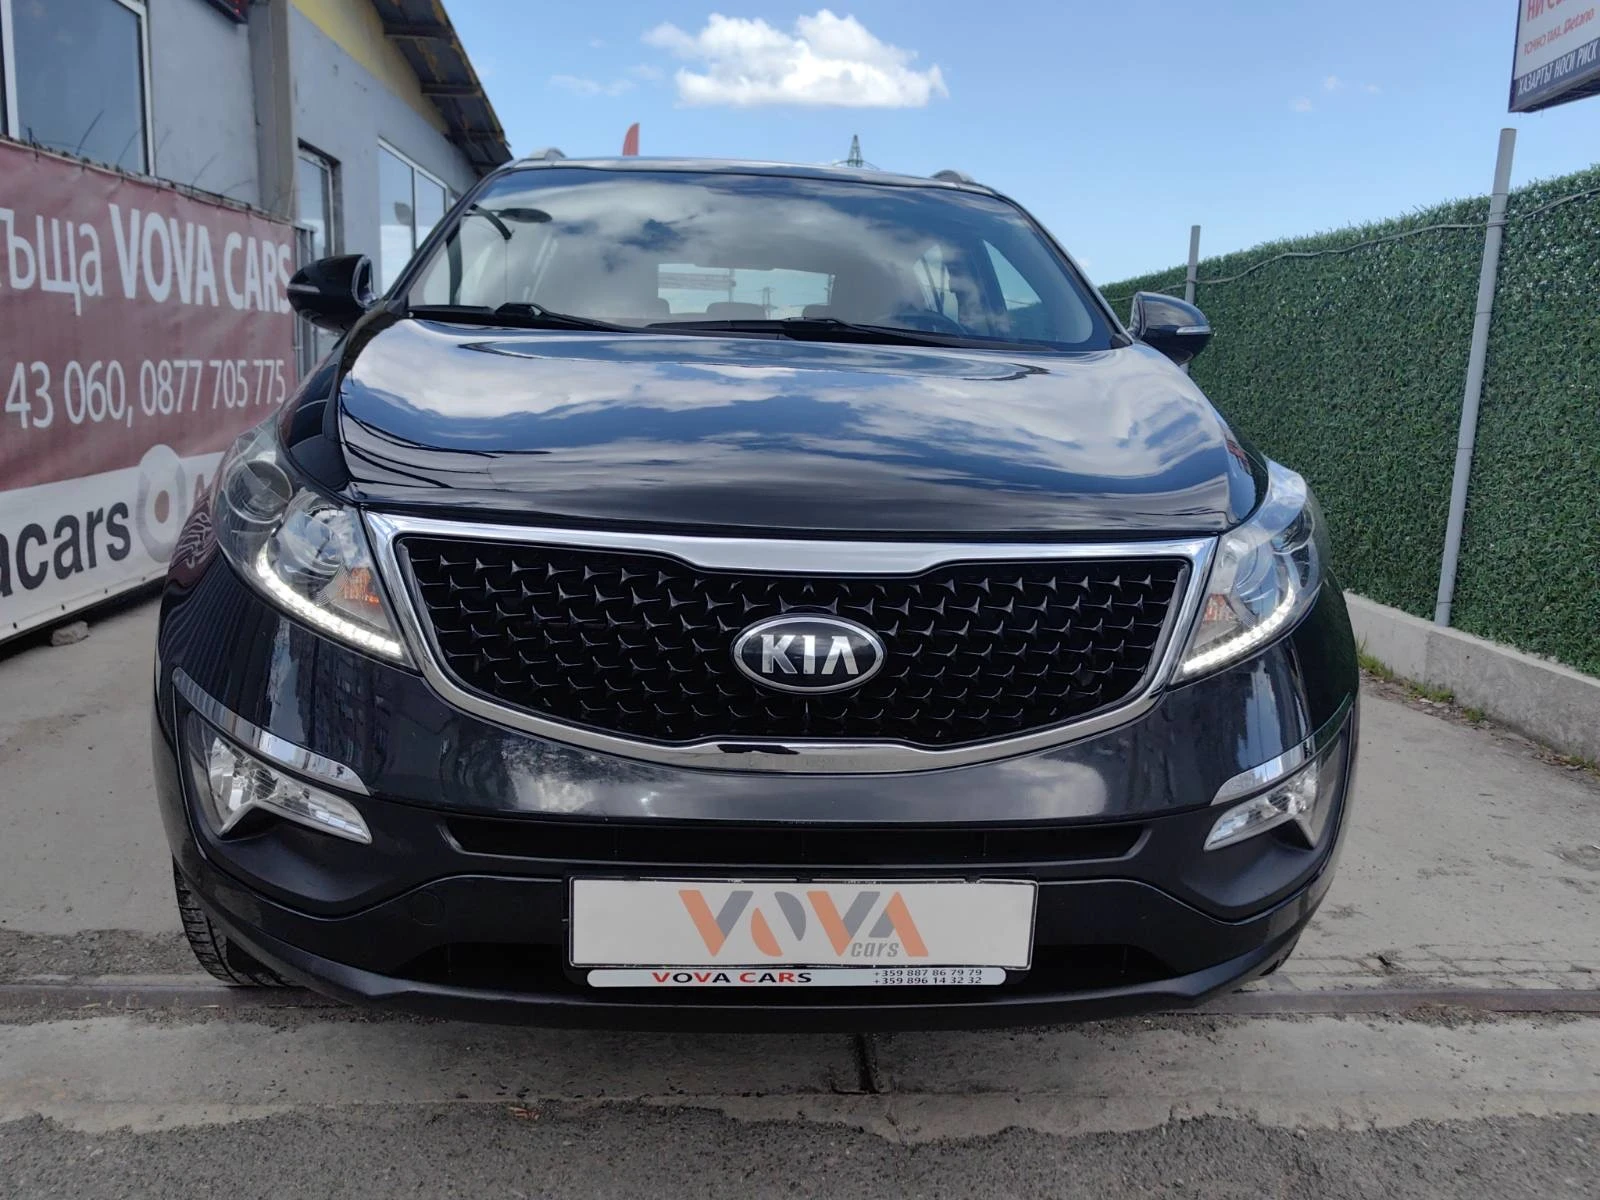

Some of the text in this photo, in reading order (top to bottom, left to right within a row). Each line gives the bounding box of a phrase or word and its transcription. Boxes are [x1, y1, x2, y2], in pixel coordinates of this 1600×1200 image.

[1554, 51, 1576, 78] НОСИ
[1577, 40, 1598, 68] РИСК
[0, 203, 291, 316] ъща VOVA CARS
[5, 359, 286, 429] 43 060, 0877 705 775
[761, 634, 859, 675] KIA
[678, 889, 929, 957] VOVA
[850, 941, 900, 958] cars
[652, 972, 812, 983] VOVA CARS
[906, 969, 929, 977] 887
[906, 977, 929, 985] 896
